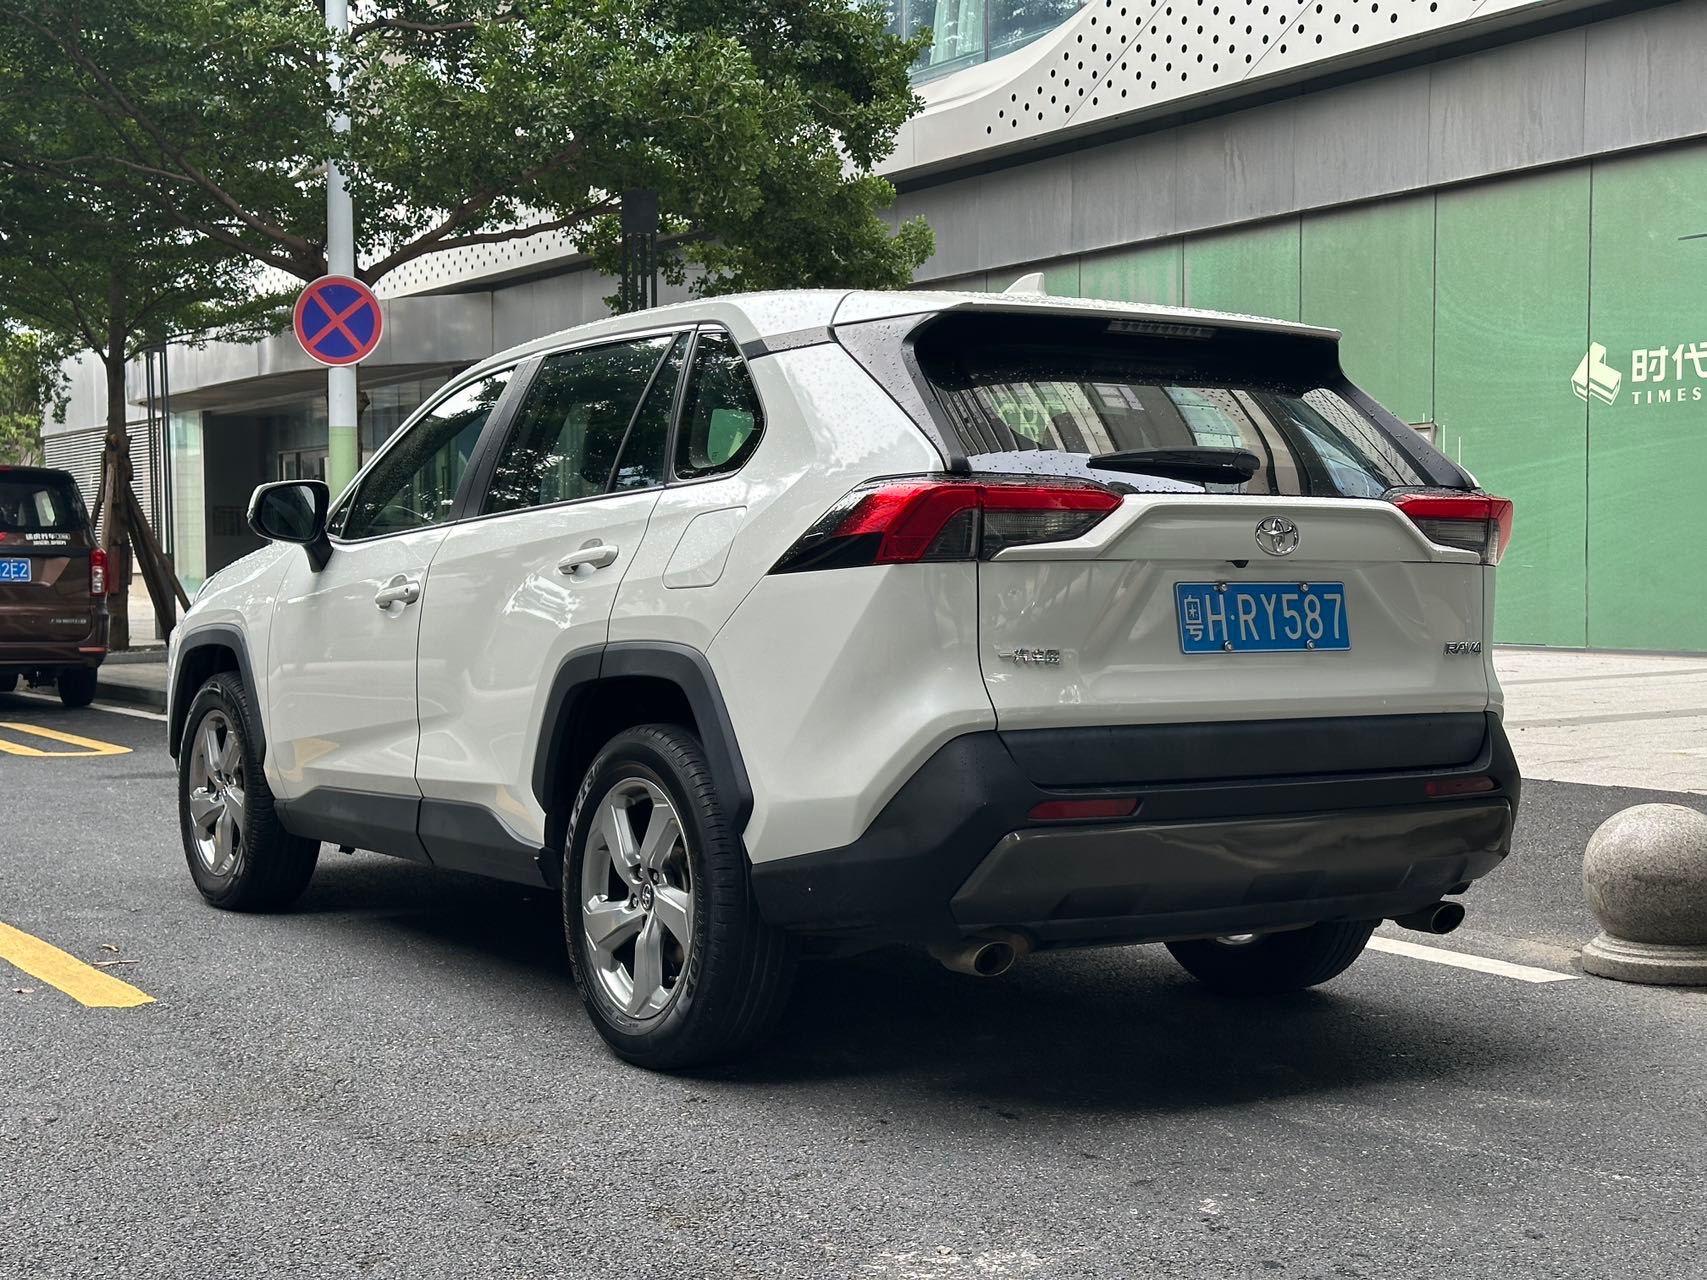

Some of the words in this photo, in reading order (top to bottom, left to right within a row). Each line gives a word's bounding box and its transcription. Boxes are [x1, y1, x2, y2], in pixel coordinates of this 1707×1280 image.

[1631, 342, 1707, 383] 时代
[1631, 387, 1702, 405] TIMES
[0, 562, 28, 578] 2E2
[1184, 593, 1342, 642] 粤H·RY587
[1443, 640, 1481, 655] RAV4
